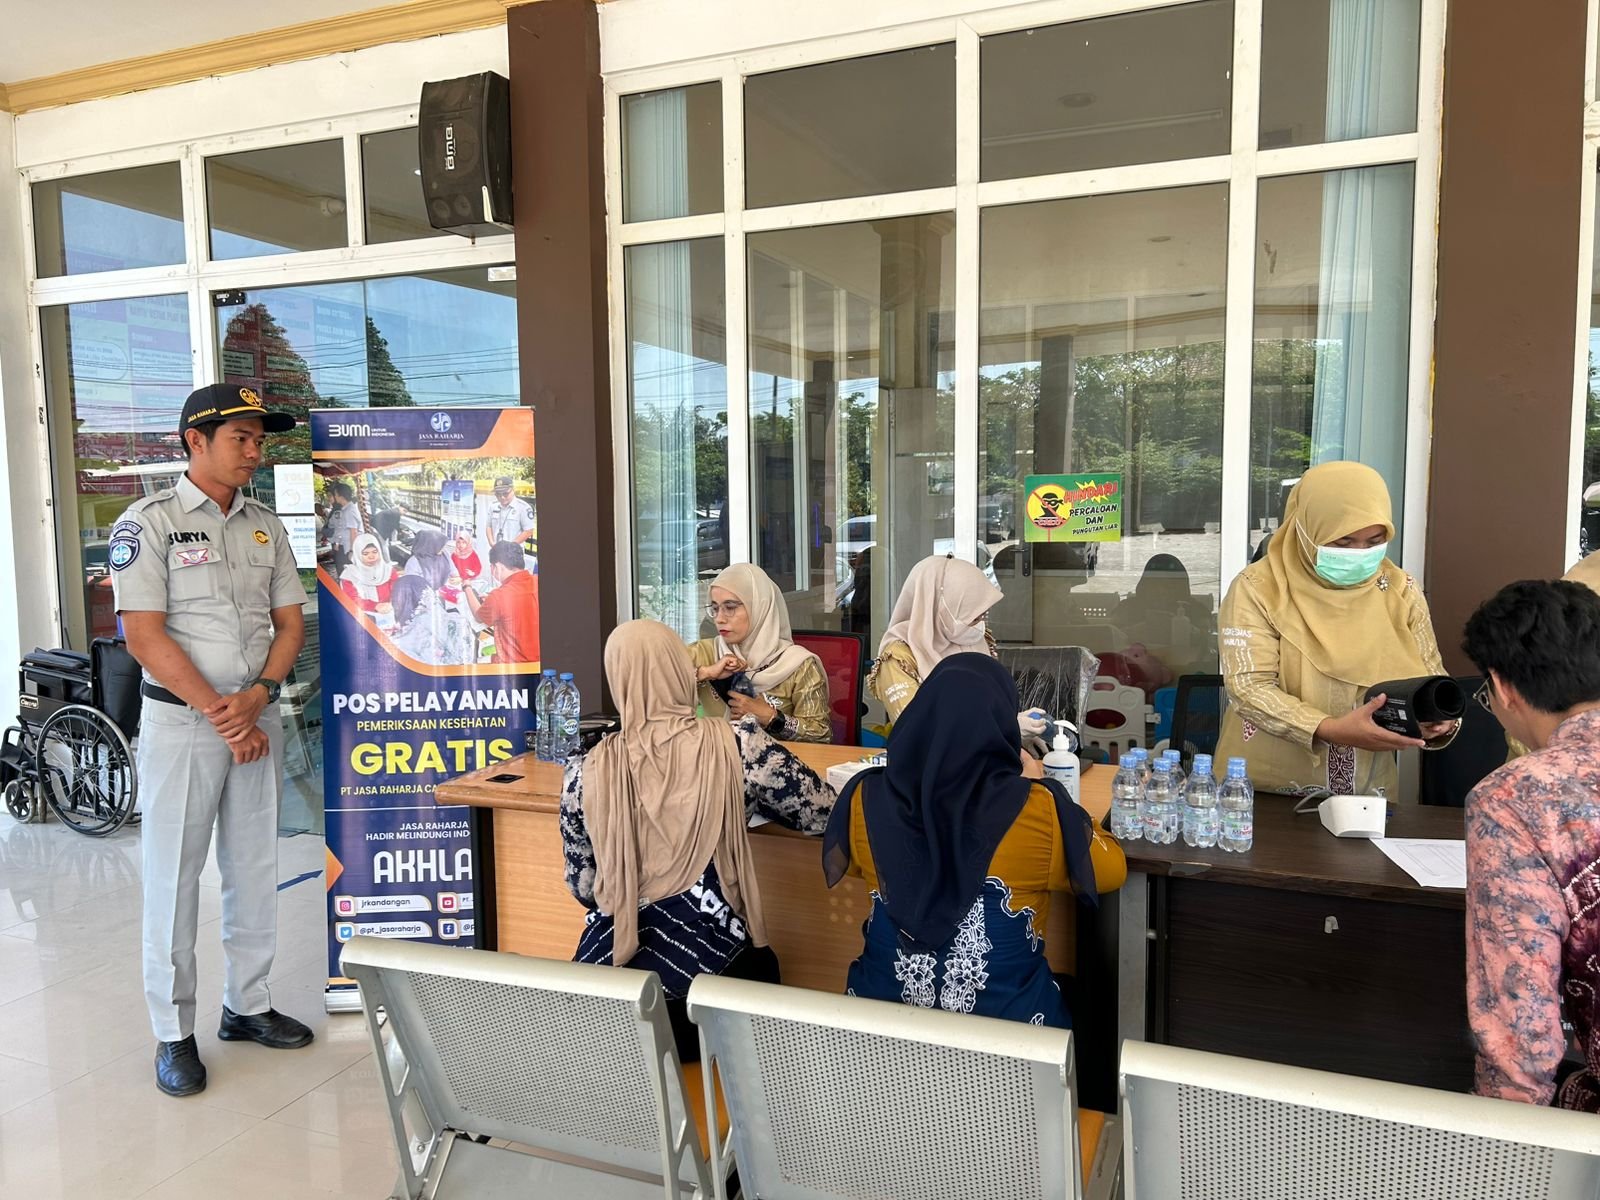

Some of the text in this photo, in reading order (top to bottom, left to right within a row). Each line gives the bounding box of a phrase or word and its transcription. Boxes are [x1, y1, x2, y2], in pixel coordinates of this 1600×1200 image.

[418, 432, 465, 440] JASA RAHARJA
[1064, 482, 1118, 503] HINDARI
[1069, 505, 1117, 516] PERCALOAN
[1086, 516, 1103, 525] DAN
[1072, 526, 1104, 535] PUNGUTAN
[168, 531, 211, 546] SURYA
[333, 688, 529, 714] POS PELAYANAN
[357, 717, 506, 732] PEMERIKSAAN KESEHATAN
[350, 738, 513, 775] GRATIS
[340, 786, 351, 796] PT
[353, 785, 378, 795] JASA
[379, 784, 423, 794] RAHARJA
[400, 820, 469, 831] JASA RAHARJA
[365, 832, 395, 841] HADIR
[396, 830, 452, 840] MELINDUNGI
[361, 899, 411, 908] jrkandangan
[359, 925, 421, 935] @pt_jasaraharja
